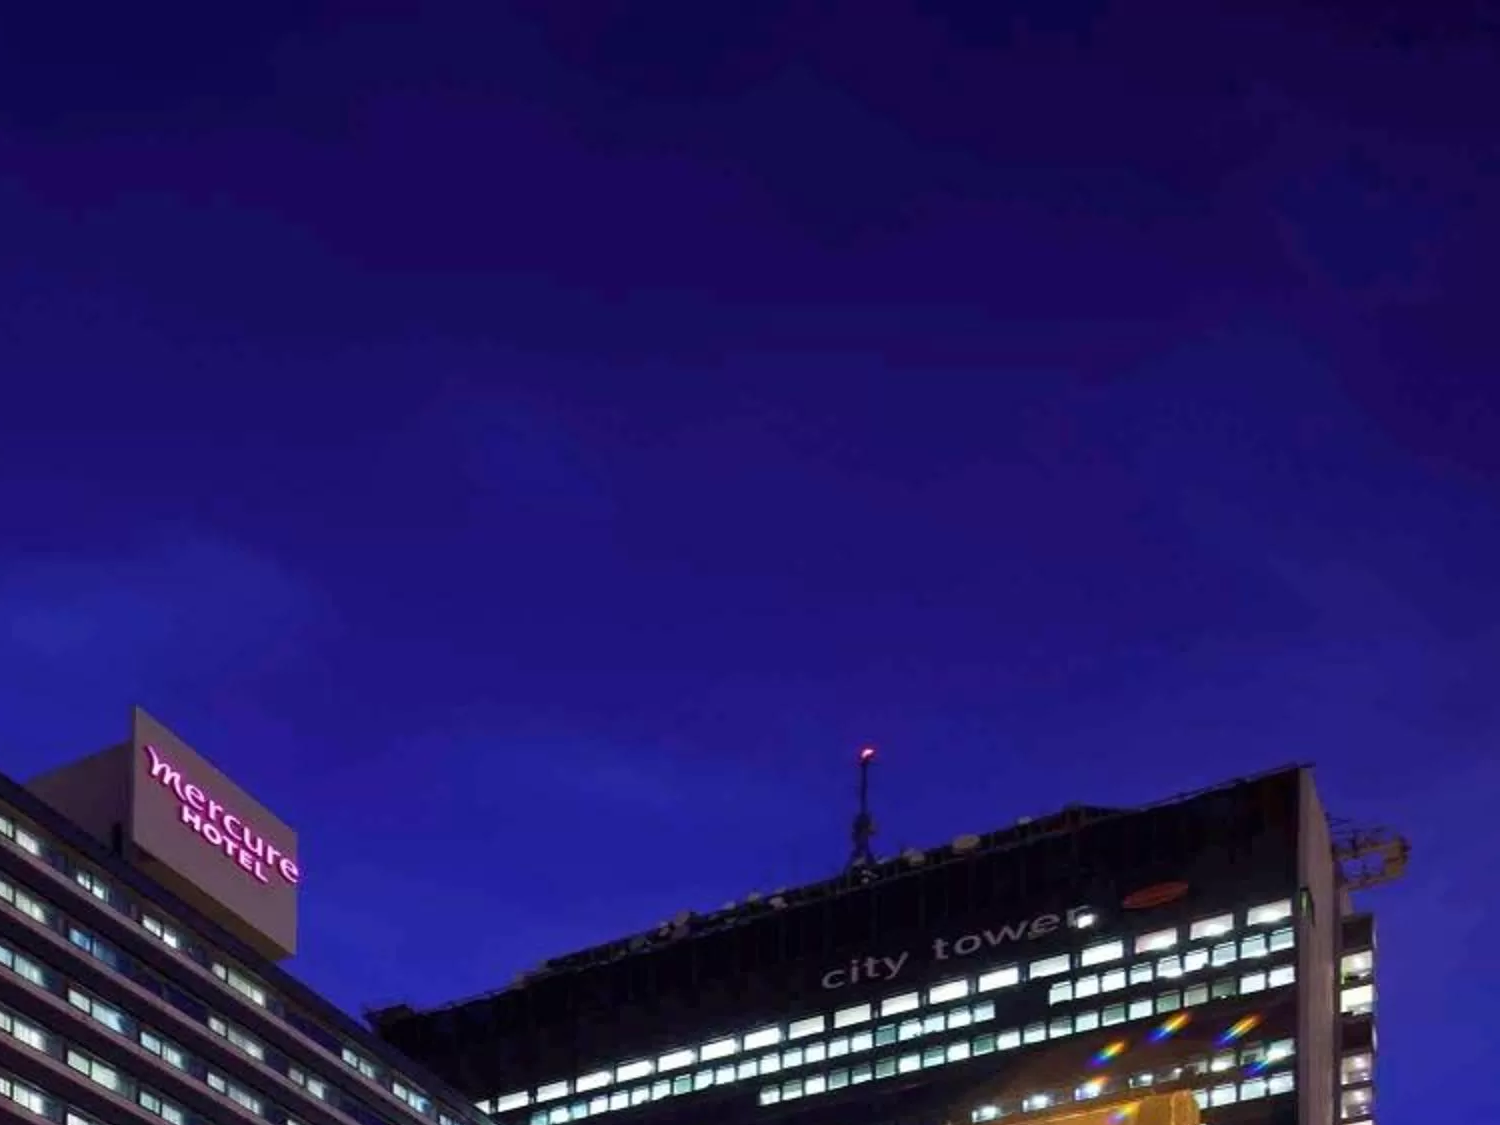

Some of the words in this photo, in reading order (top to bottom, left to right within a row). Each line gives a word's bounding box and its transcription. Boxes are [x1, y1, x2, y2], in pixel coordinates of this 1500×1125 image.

[179, 804, 269, 884] HOTEL
[821, 951, 909, 989] city
[931, 904, 1097, 960] tower
